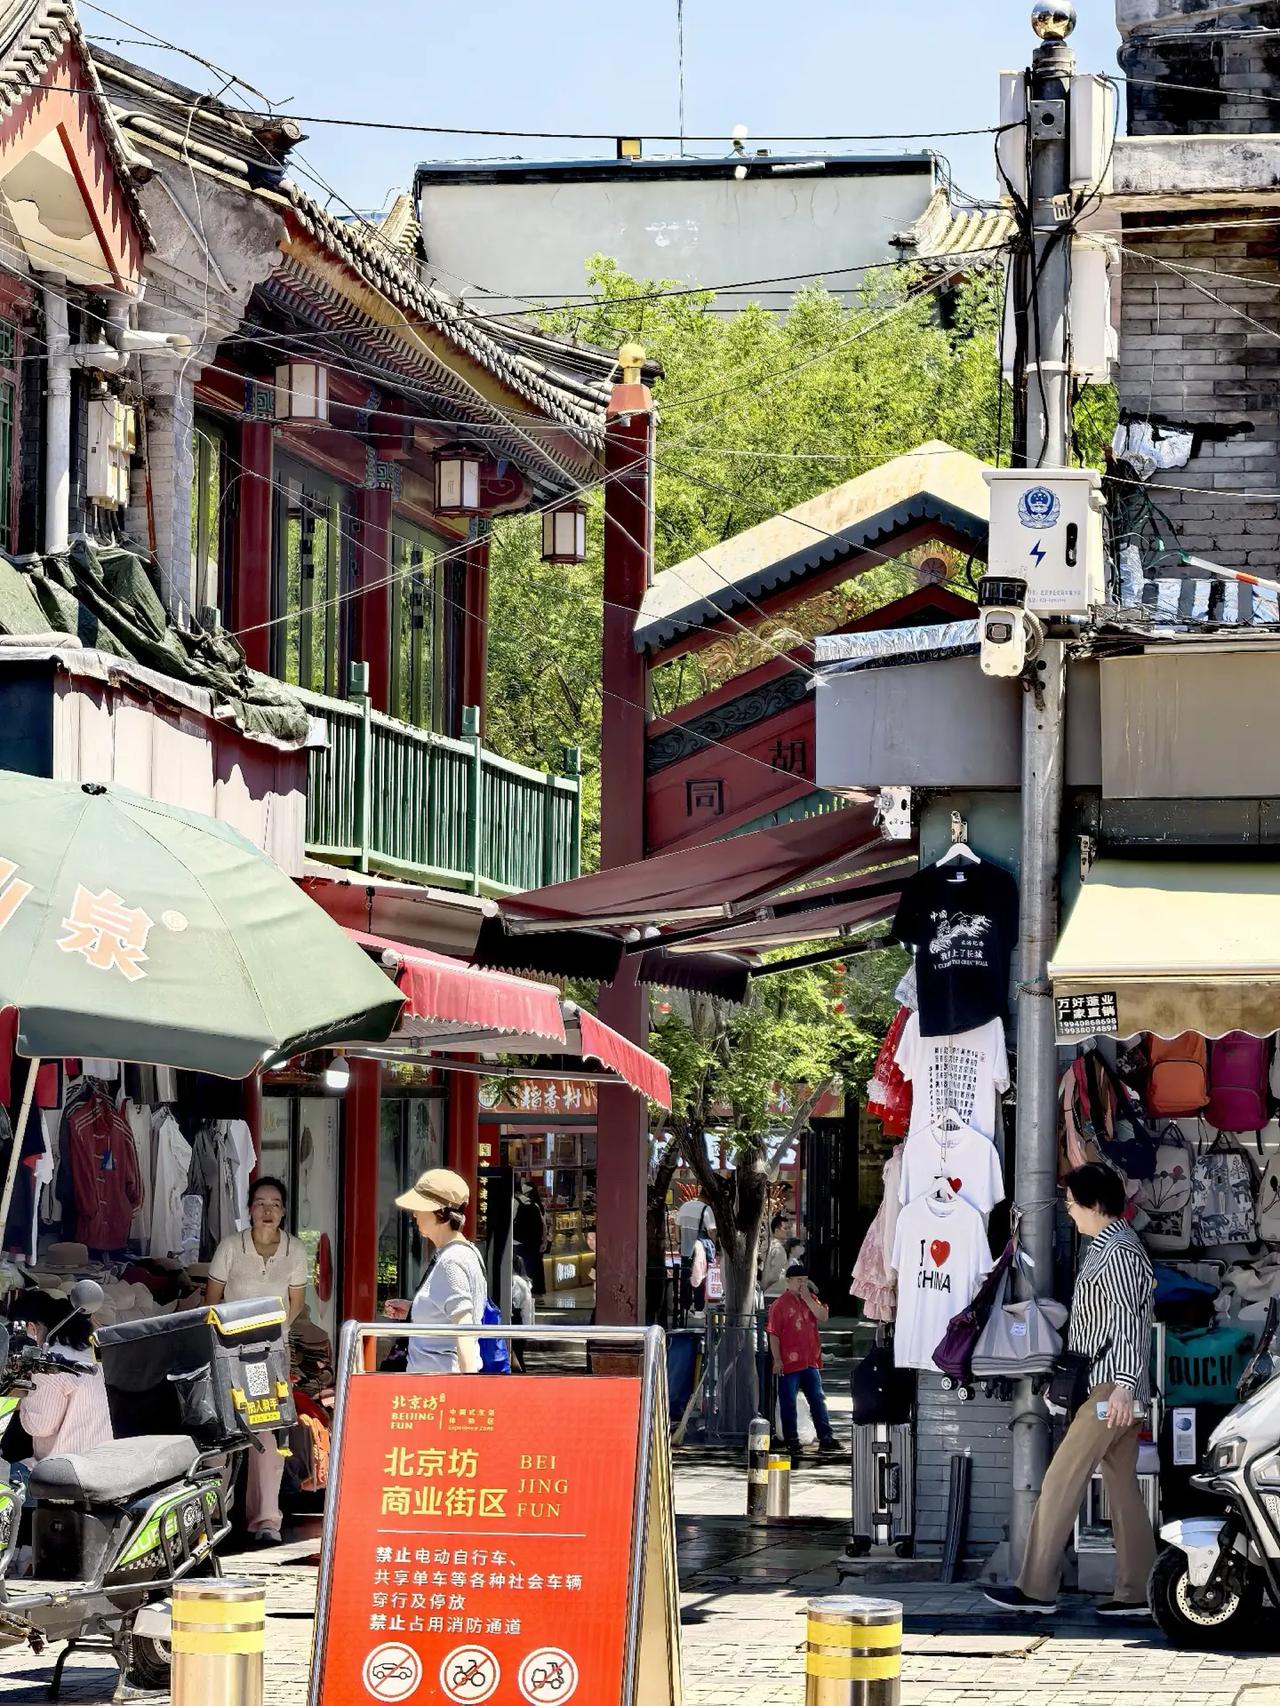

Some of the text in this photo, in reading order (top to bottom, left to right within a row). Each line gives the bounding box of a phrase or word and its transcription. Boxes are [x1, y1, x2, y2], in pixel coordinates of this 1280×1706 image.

[919, 1239, 926, 1267] I
[917, 1270, 951, 1294] CHINA
[391, 1395, 438, 1410] 北京坊
[390, 1421, 413, 1430] FUN
[391, 1412, 435, 1421] BEIJING
[383, 1446, 479, 1478] 北京坊
[519, 1454, 557, 1470] BEI
[518, 1479, 569, 1494] JING
[380, 1485, 508, 1518] 商业街区
[517, 1503, 561, 1518] FUN
[375, 1546, 517, 1566] 禁止电动自行车、
[373, 1569, 583, 1591] 共享单车等各种社会车辆
[371, 1592, 466, 1610] 穿行及停放
[369, 1613, 522, 1635] 禁止占用消防通道
